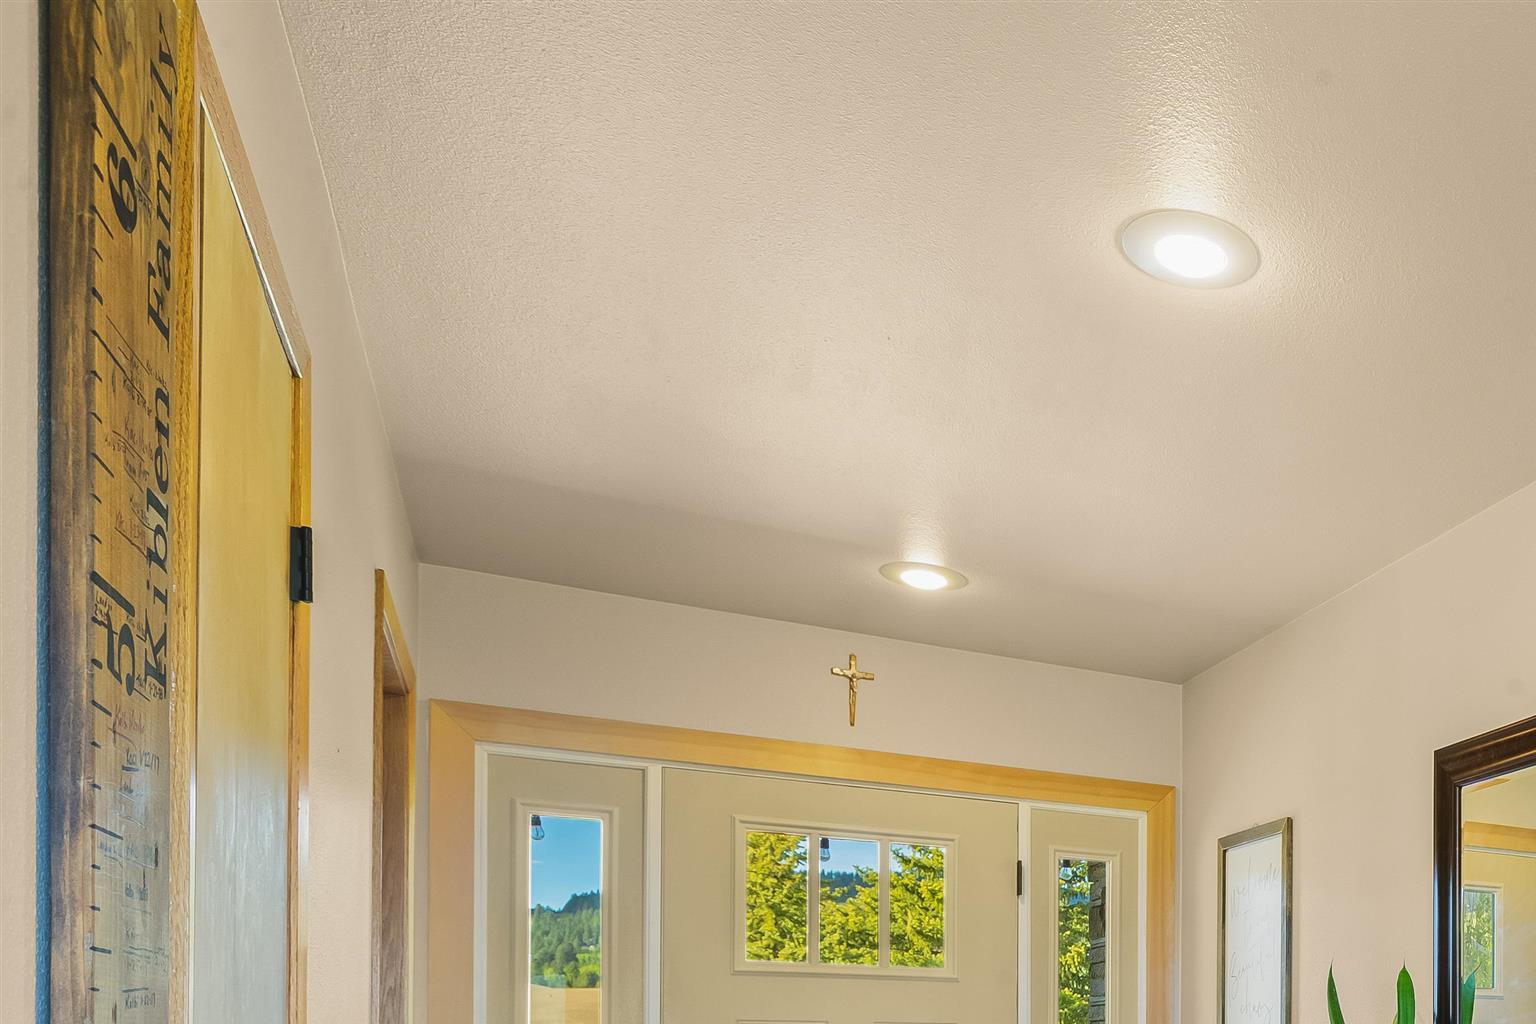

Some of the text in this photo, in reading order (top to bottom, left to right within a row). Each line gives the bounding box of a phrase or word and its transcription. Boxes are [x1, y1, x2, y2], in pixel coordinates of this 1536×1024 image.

[147, 10, 178, 354] Family
[105, 612, 137, 697] 5
[145, 386, 171, 700] Kiblen
